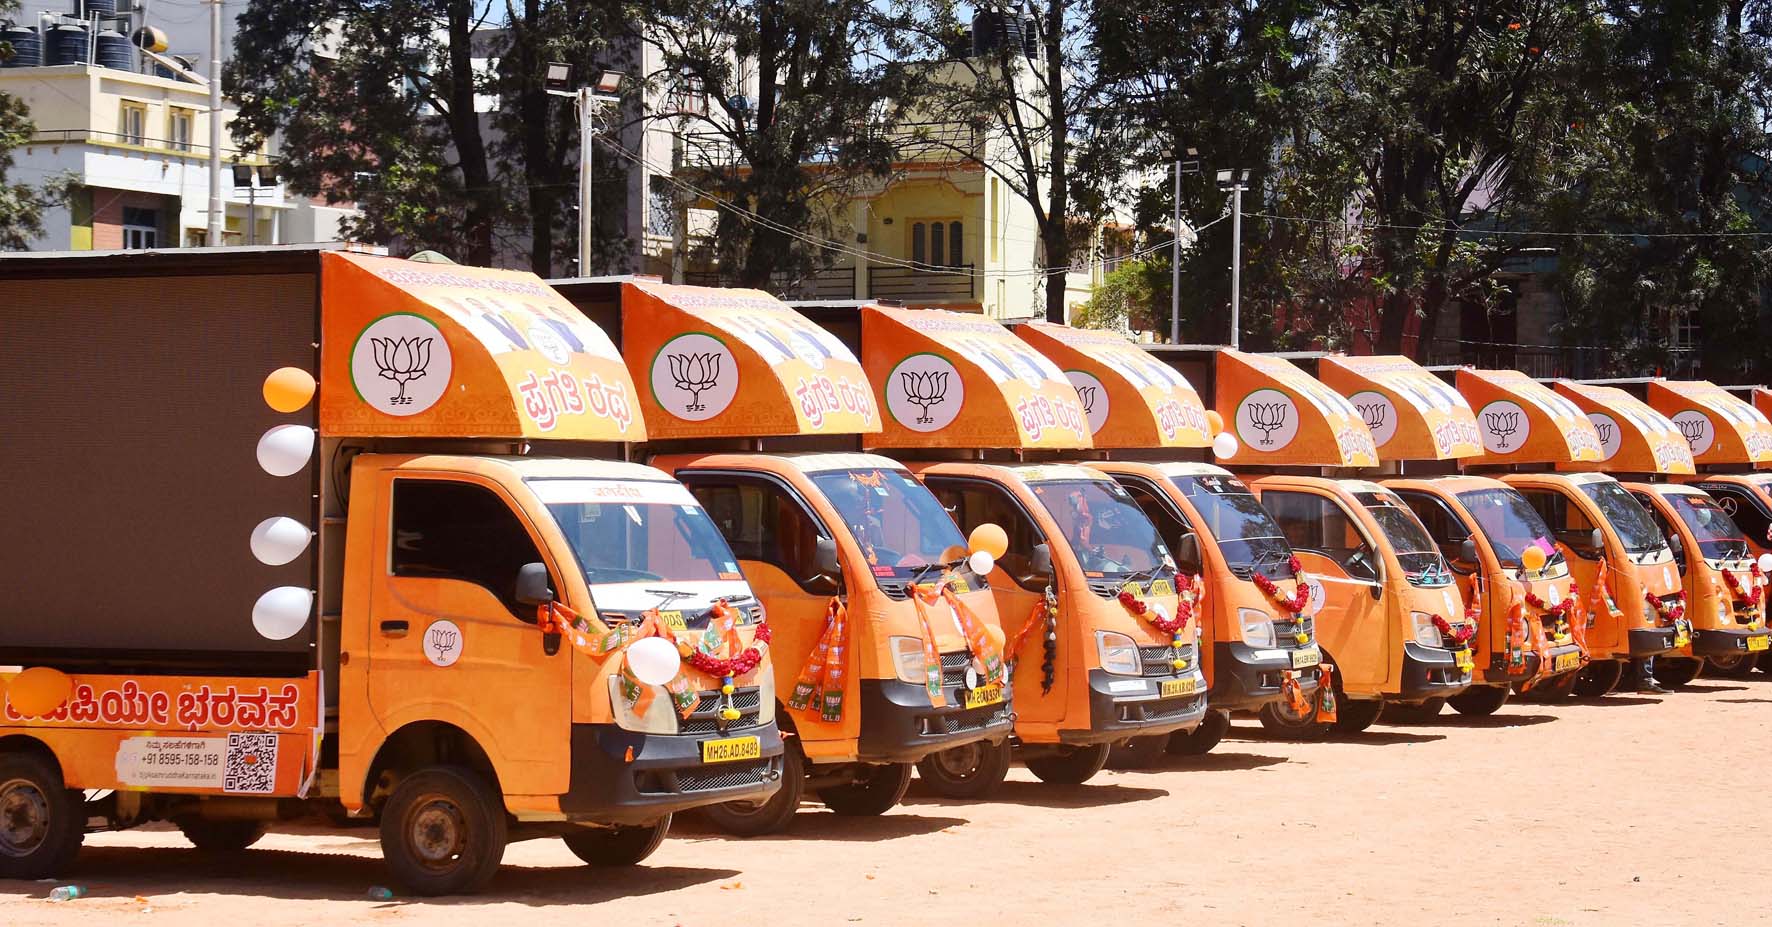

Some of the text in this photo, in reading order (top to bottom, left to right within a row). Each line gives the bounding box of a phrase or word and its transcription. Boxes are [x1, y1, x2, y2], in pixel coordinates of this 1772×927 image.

[519, 370, 585, 429] ಪ್ರಗತಿ
[796, 377, 840, 427] ಪ್ರಗತಿ
[1016, 396, 1056, 441] ಪ್ರಗತಿ
[178, 683, 299, 731] ಭರವಸೆ
[142, 753, 218, 766] +91 8595-158-158
